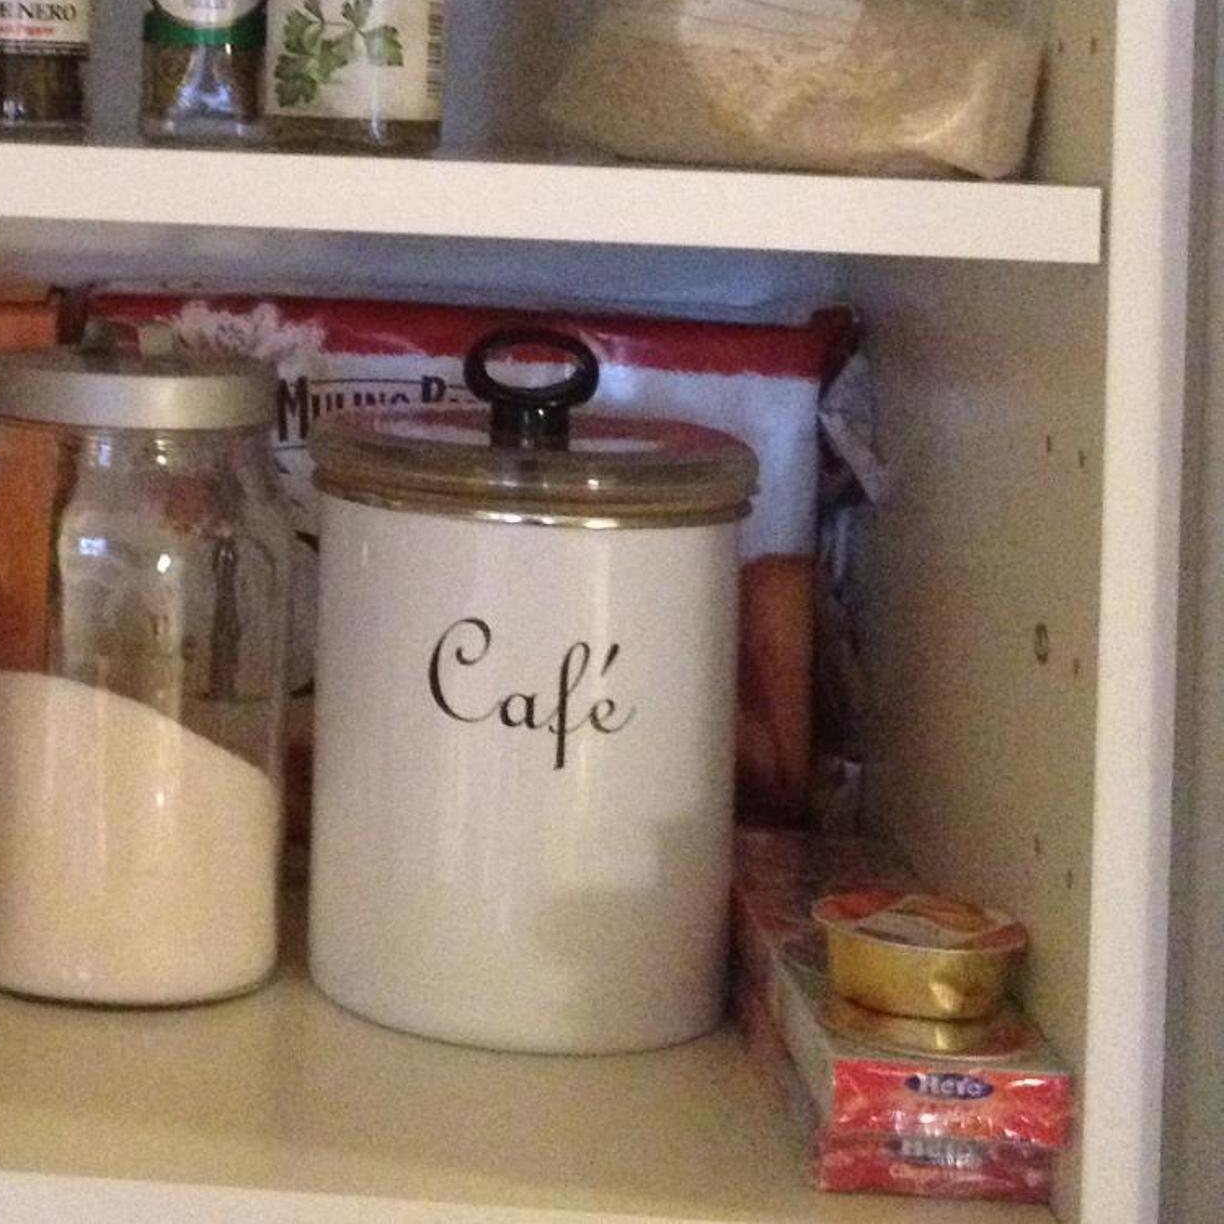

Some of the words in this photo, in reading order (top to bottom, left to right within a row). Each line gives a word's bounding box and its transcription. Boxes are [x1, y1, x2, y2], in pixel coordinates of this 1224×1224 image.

[18, 2, 78, 22] NERO
[428, 617, 639, 770] Café
[918, 1073, 982, 1096] Hero
